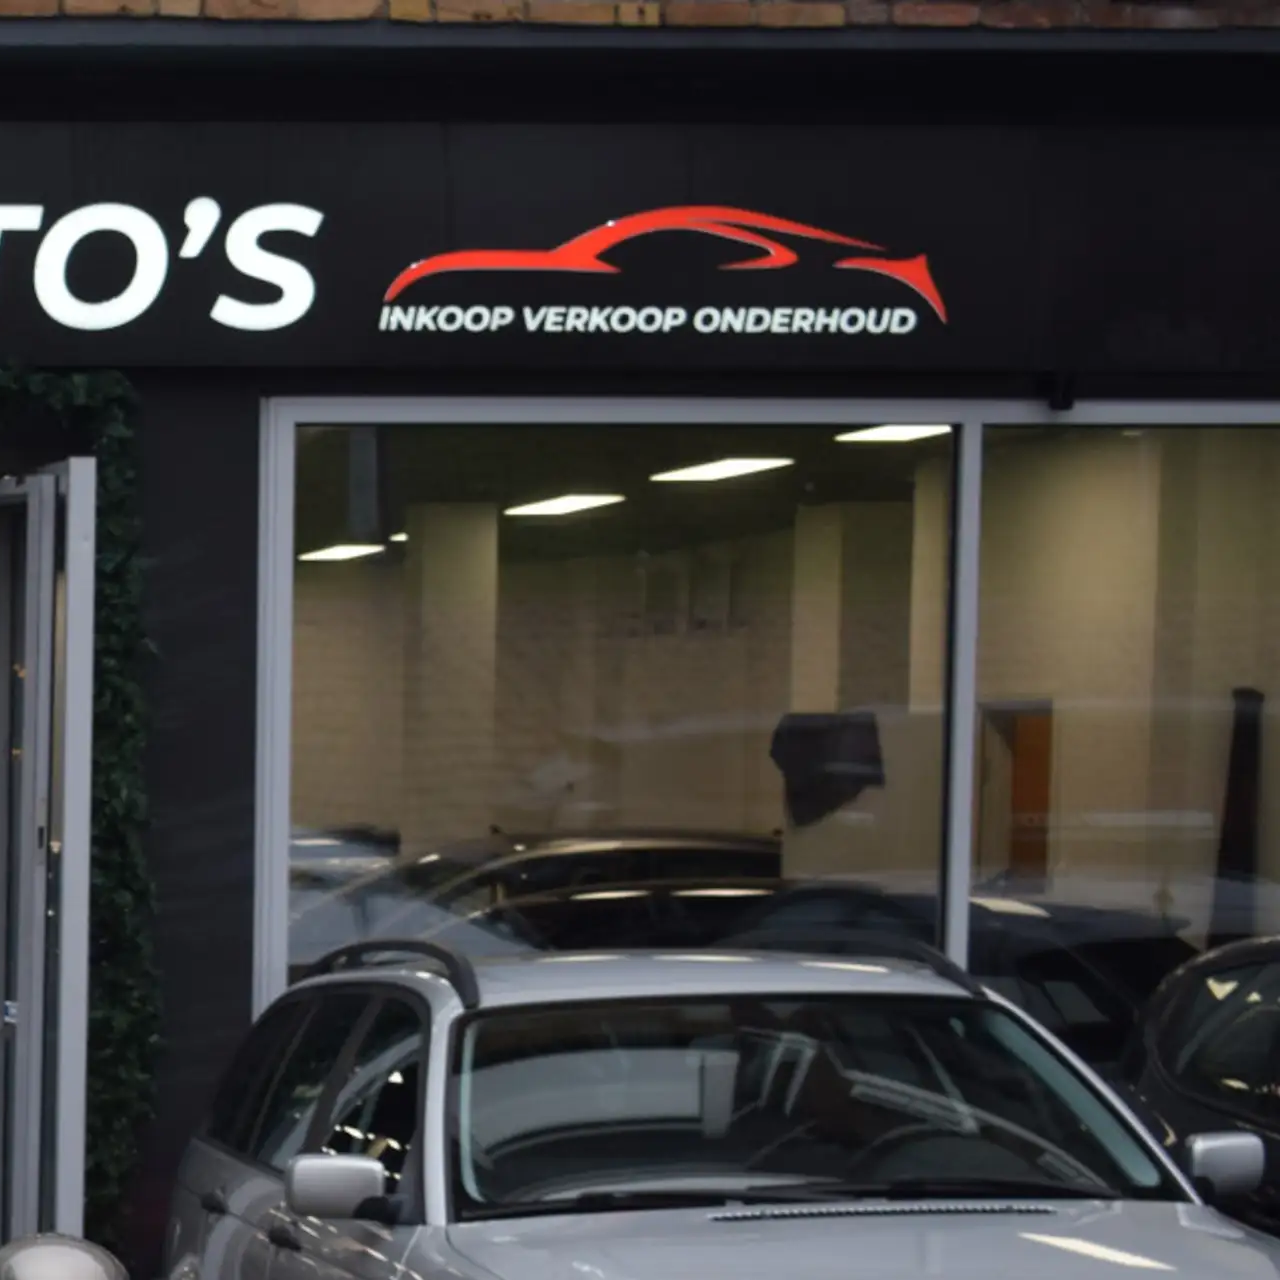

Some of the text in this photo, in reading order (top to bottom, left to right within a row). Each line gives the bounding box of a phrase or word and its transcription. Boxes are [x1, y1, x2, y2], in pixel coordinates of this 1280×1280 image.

[378, 305, 917, 335] INKOOP VERKOOP ONDERHOUD
